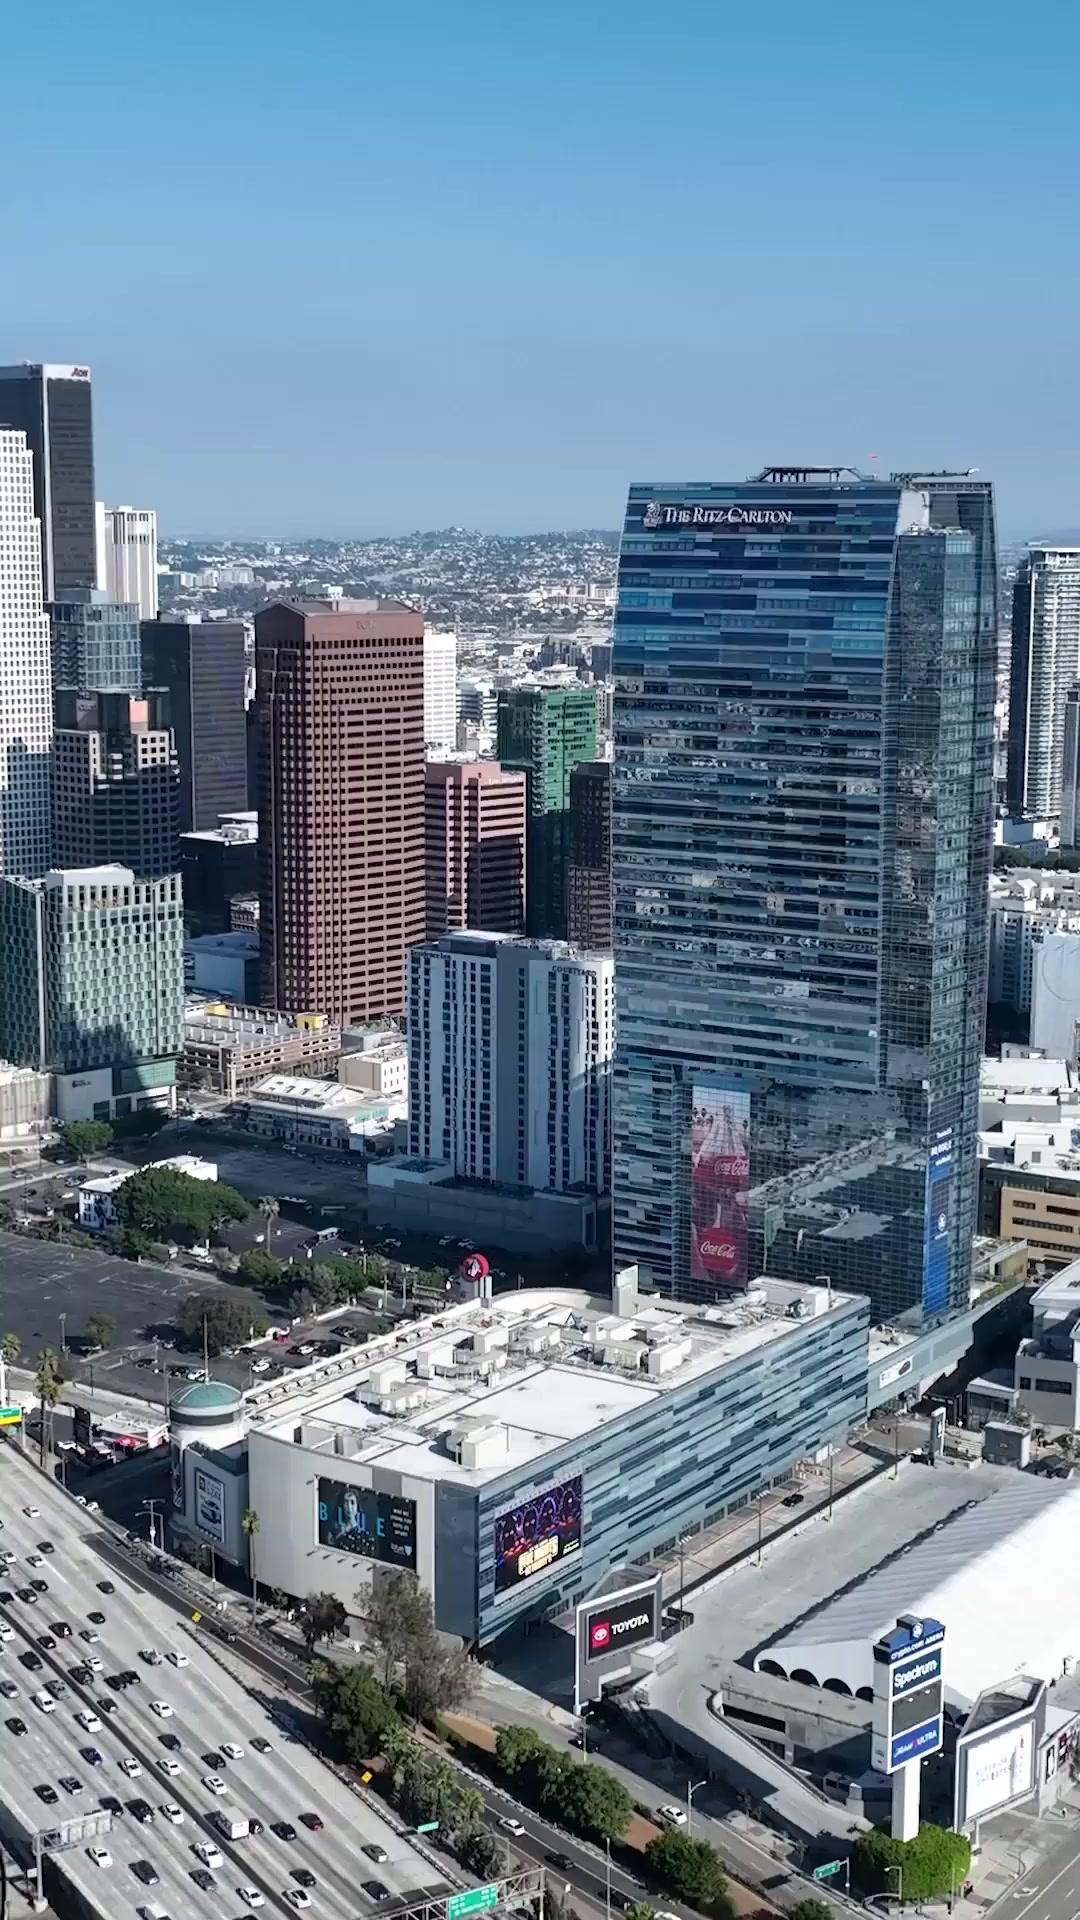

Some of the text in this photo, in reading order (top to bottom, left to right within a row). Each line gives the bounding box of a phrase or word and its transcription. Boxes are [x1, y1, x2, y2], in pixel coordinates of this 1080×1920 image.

[664, 506, 793, 524] THE RITZ-CARLTON
[611, 1613, 650, 1635] TOYOTA
[890, 1640, 924, 1660] crypto.com
[894, 1658, 938, 1688] Spectrum
